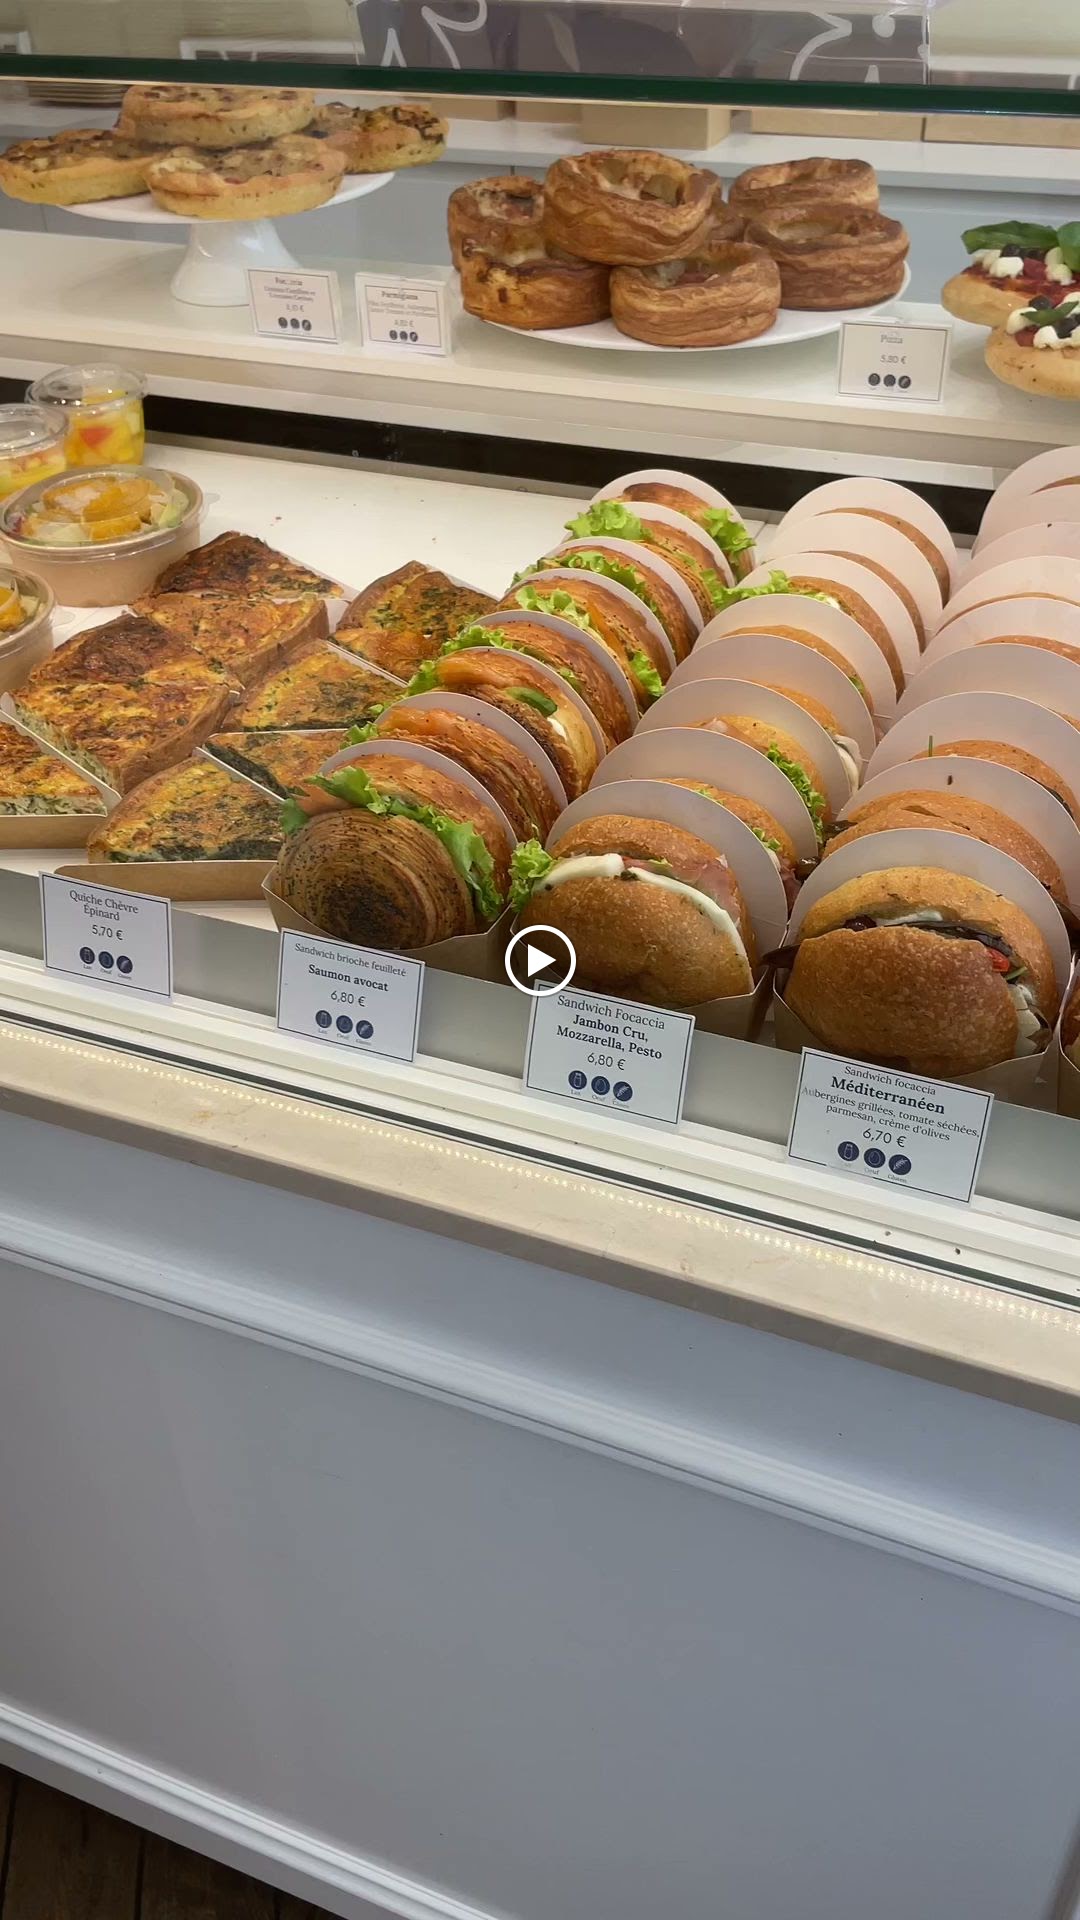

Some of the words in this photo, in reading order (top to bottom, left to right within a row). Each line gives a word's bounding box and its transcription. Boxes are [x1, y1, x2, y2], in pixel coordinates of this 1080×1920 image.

[69, 890, 103, 906] Quiche
[105, 898, 139, 914] Chèvre
[83, 904, 120, 921] Épinard
[92, 924, 113, 938] 5,70
[116, 930, 124, 940] €
[294, 943, 335, 960] Sandwich
[336, 952, 370, 968] brioche
[371, 961, 407, 977] feuilleté
[308, 964, 351, 983] Saumon
[353, 977, 389, 992] avocat
[330, 990, 355, 1004] 6,80
[358, 996, 366, 1007] €
[557, 995, 612, 1018] Sandwich
[615, 1008, 665, 1030] Focaccia
[556, 1025, 626, 1052] Mozzarella,
[628, 1042, 663, 1060] Pesto
[572, 1014, 619, 1035] Jambon
[622, 1026, 649, 1043] Cru,
[587, 1052, 614, 1068] 6,80
[617, 1058, 626, 1071] €
[844, 1065, 892, 1086] Sandwich
[894, 1077, 936, 1096] focaccia
[830, 1076, 946, 1115] Méditerranéen
[801, 1086, 856, 1108] Aubergines
[857, 1101, 897, 1118] grillées,
[898, 1110, 935, 1127] tomate
[936, 1120, 980, 1139] séchées,
[826, 1105, 877, 1125] parmesan,
[878, 1117, 911, 1132] crème
[912, 1125, 951, 1142] d'olives
[862, 1128, 892, 1145] 6,70
[896, 1135, 908, 1148] €
